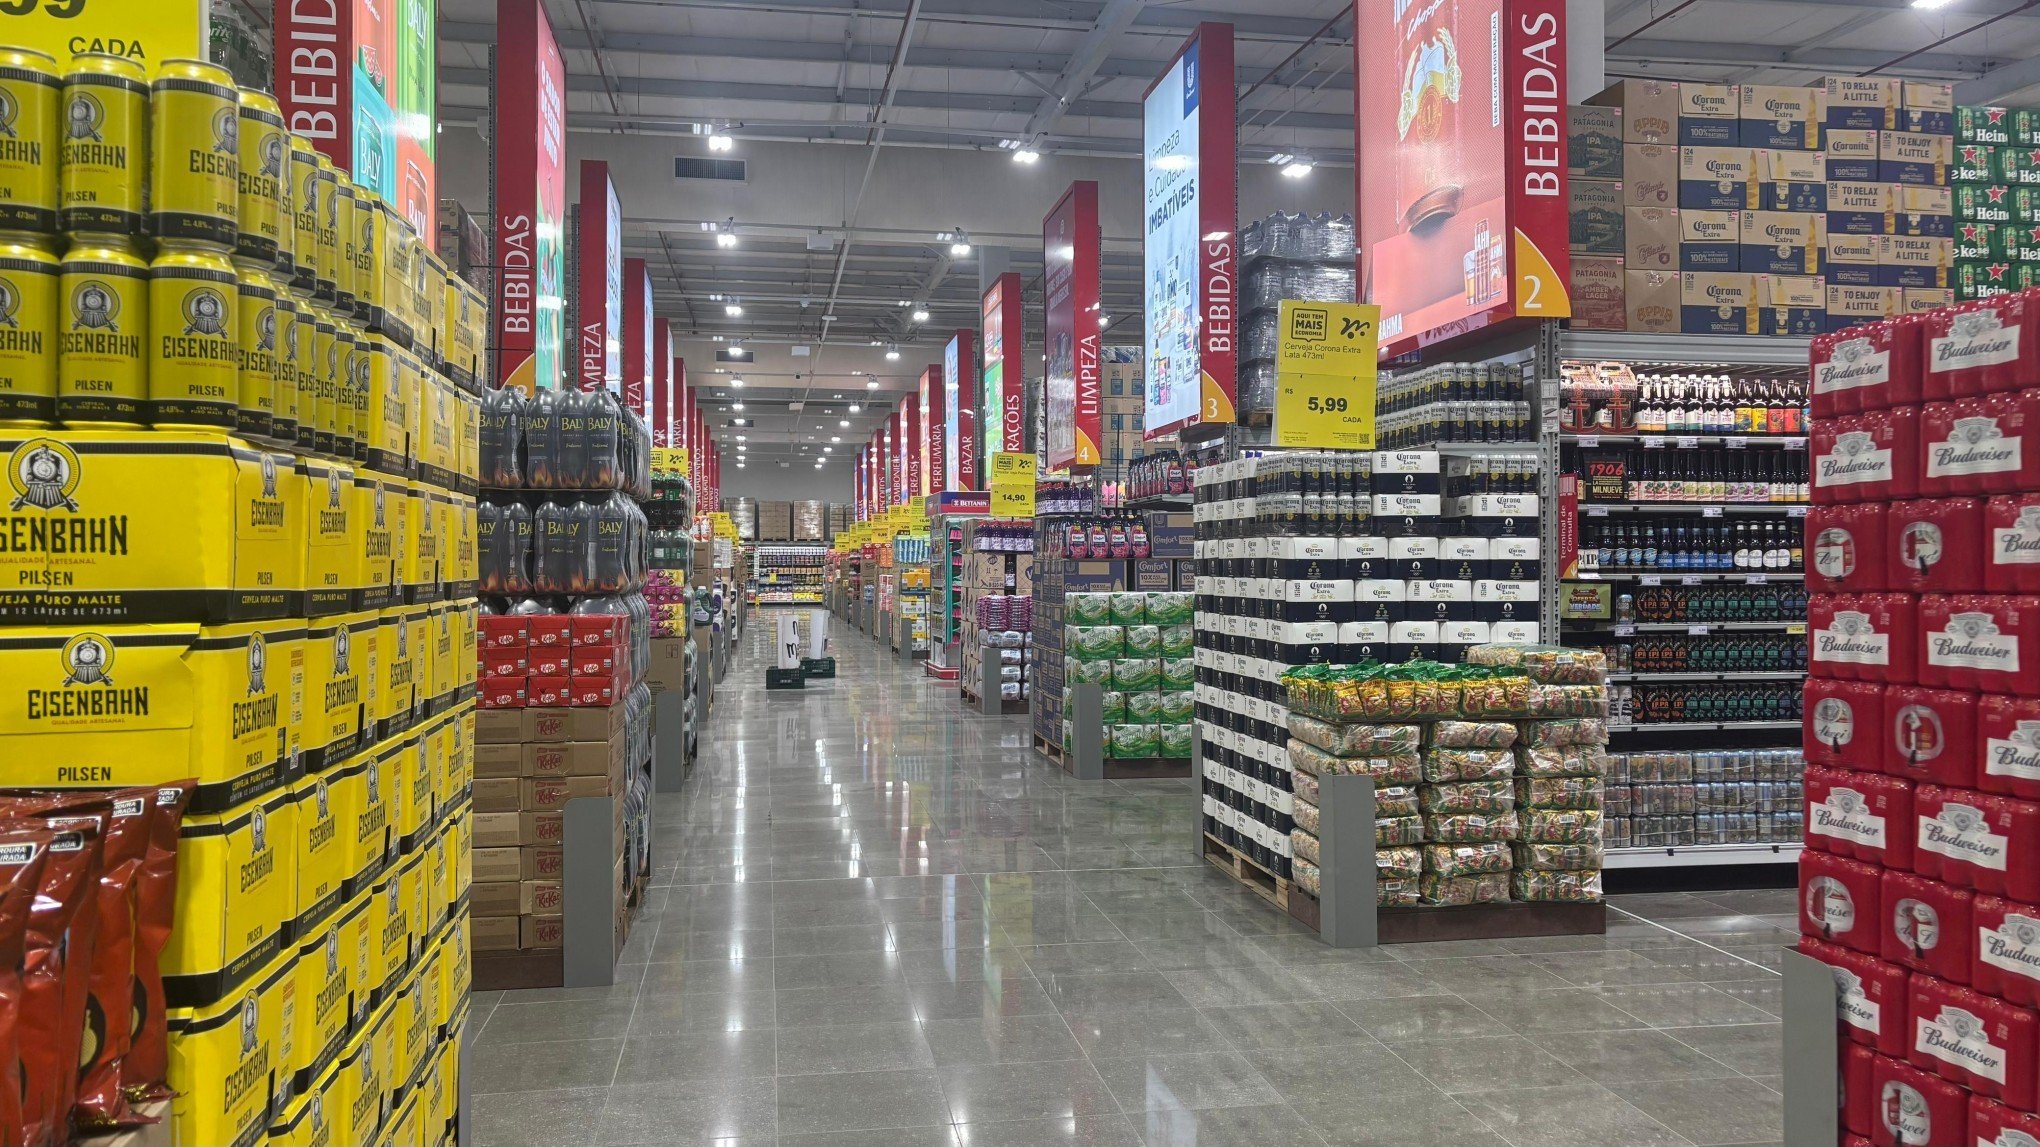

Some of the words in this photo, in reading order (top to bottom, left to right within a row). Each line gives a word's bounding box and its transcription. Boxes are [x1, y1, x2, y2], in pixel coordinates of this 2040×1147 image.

[68, 37, 145, 59] CADA
[1841, 81, 1851, 90] TO
[1853, 82, 1878, 91] RELAX
[1691, 94, 1725, 106] Corona
[1851, 93, 1878, 101] LITTLE
[1521, 12, 1560, 196] BEBIDAS
[1765, 99, 1800, 111] Corona
[1774, 110, 1793, 118] Extra
[1573, 118, 1614, 128] PATAGONIA
[1690, 128, 1708, 137] 100%
[1586, 136, 1602, 145] IPA
[1833, 141, 1869, 151] Coronita
[1897, 137, 1907, 145] TO
[1908, 138, 1931, 147] ENJOY
[1897, 148, 1903, 156] A
[1904, 149, 1930, 158] LITTLE
[361, 137, 382, 188] BALY
[1706, 160, 1742, 171] Corona
[66, 191, 96, 202] PILSEN
[1842, 186, 1852, 195] TO
[1853, 187, 1878, 195] RELAX
[1574, 193, 1616, 203] PATAGONIA
[1843, 198, 1849, 206] A
[1851, 198, 1877, 206] LITTLE
[1148, 178, 1195, 235] IMBATÍVEIS
[1587, 212, 1602, 220] IPA
[1693, 220, 1726, 232] Corona
[1765, 224, 1800, 236] Corona
[1834, 245, 1871, 255] Coronita
[1894, 240, 1904, 249] TO
[1905, 241, 1930, 249] RELAX
[1690, 254, 1707, 262] 100%
[1903, 252, 1928, 260] LITTLE
[504, 215, 530, 333] BEBIDAS
[1575, 269, 1617, 279] PATAGONIA
[1523, 275, 1542, 309] 2
[1706, 285, 1742, 297] Corona
[1843, 290, 1854, 299] TO
[1855, 291, 1880, 299] ENJOY
[1208, 243, 1231, 352] BEBIDAS
[1845, 302, 1851, 310] A
[1852, 302, 1879, 310] LITTLE
[1295, 320, 1323, 330] MAIS
[1284, 342, 1313, 352] Cerveja
[1314, 344, 1341, 353] Corona
[1938, 338, 2012, 361] Budweiser
[1284, 351, 1300, 359] Lata
[1302, 352, 1325, 360] 473ml
[1080, 335, 1097, 414] LIMPEZA
[1820, 363, 1883, 384] Budweiser
[75, 380, 113, 392] PILSEN
[189, 384, 225, 397] PILSEN
[1207, 398, 1218, 418] 3
[1307, 397, 1348, 415] 5,99
[526, 417, 549, 430] BALY
[588, 417, 612, 430] BALY
[1004, 394, 1022, 451] RAÇÕES
[932, 424, 942, 487] PERFUMARIA
[962, 436, 973, 474] BAZAR
[1079, 446, 1089, 461] 4
[1396, 453, 1421, 461] Corona
[1935, 447, 2013, 466] Budweiser
[1589, 463, 1624, 476] 1906
[1821, 458, 1885, 477] Budweiser
[1592, 485, 1622, 494] MILNUEVE
[1002, 494, 1026, 502] 14,90
[1396, 496, 1421, 504] Corona
[1497, 496, 1521, 504] Corona
[1561, 505, 1565, 517] de
[600, 522, 622, 534] BALY
[1153, 535, 1178, 545] Comfort
[49, 557, 97, 565] ARTESANAL
[1139, 561, 1168, 572] Comfort
[19, 570, 73, 586] PILSEN
[257, 572, 273, 585] PILSEN
[1065, 582, 1089, 592] Comfort
[1310, 581, 1335, 589] Corona
[35, 594, 72, 606] PURO
[78, 594, 122, 605] MALTE
[15, 606, 27, 616] 12
[1819, 635, 1882, 654] Budweiser
[1934, 637, 2011, 659] Budweiser
[325, 674, 359, 713] EISENBAHN
[28, 686, 149, 720] EISENBAHN
[232, 692, 278, 740] EISENBAHN
[245, 751, 263, 768] PILSEN
[58, 766, 111, 782] PILSEN
[1815, 809, 1879, 837] Budweiser
[1926, 823, 1999, 857] Budweiser
[1923, 1025, 1998, 1069] Budweiser
[223, 1040, 270, 1115] EISENBAHN
